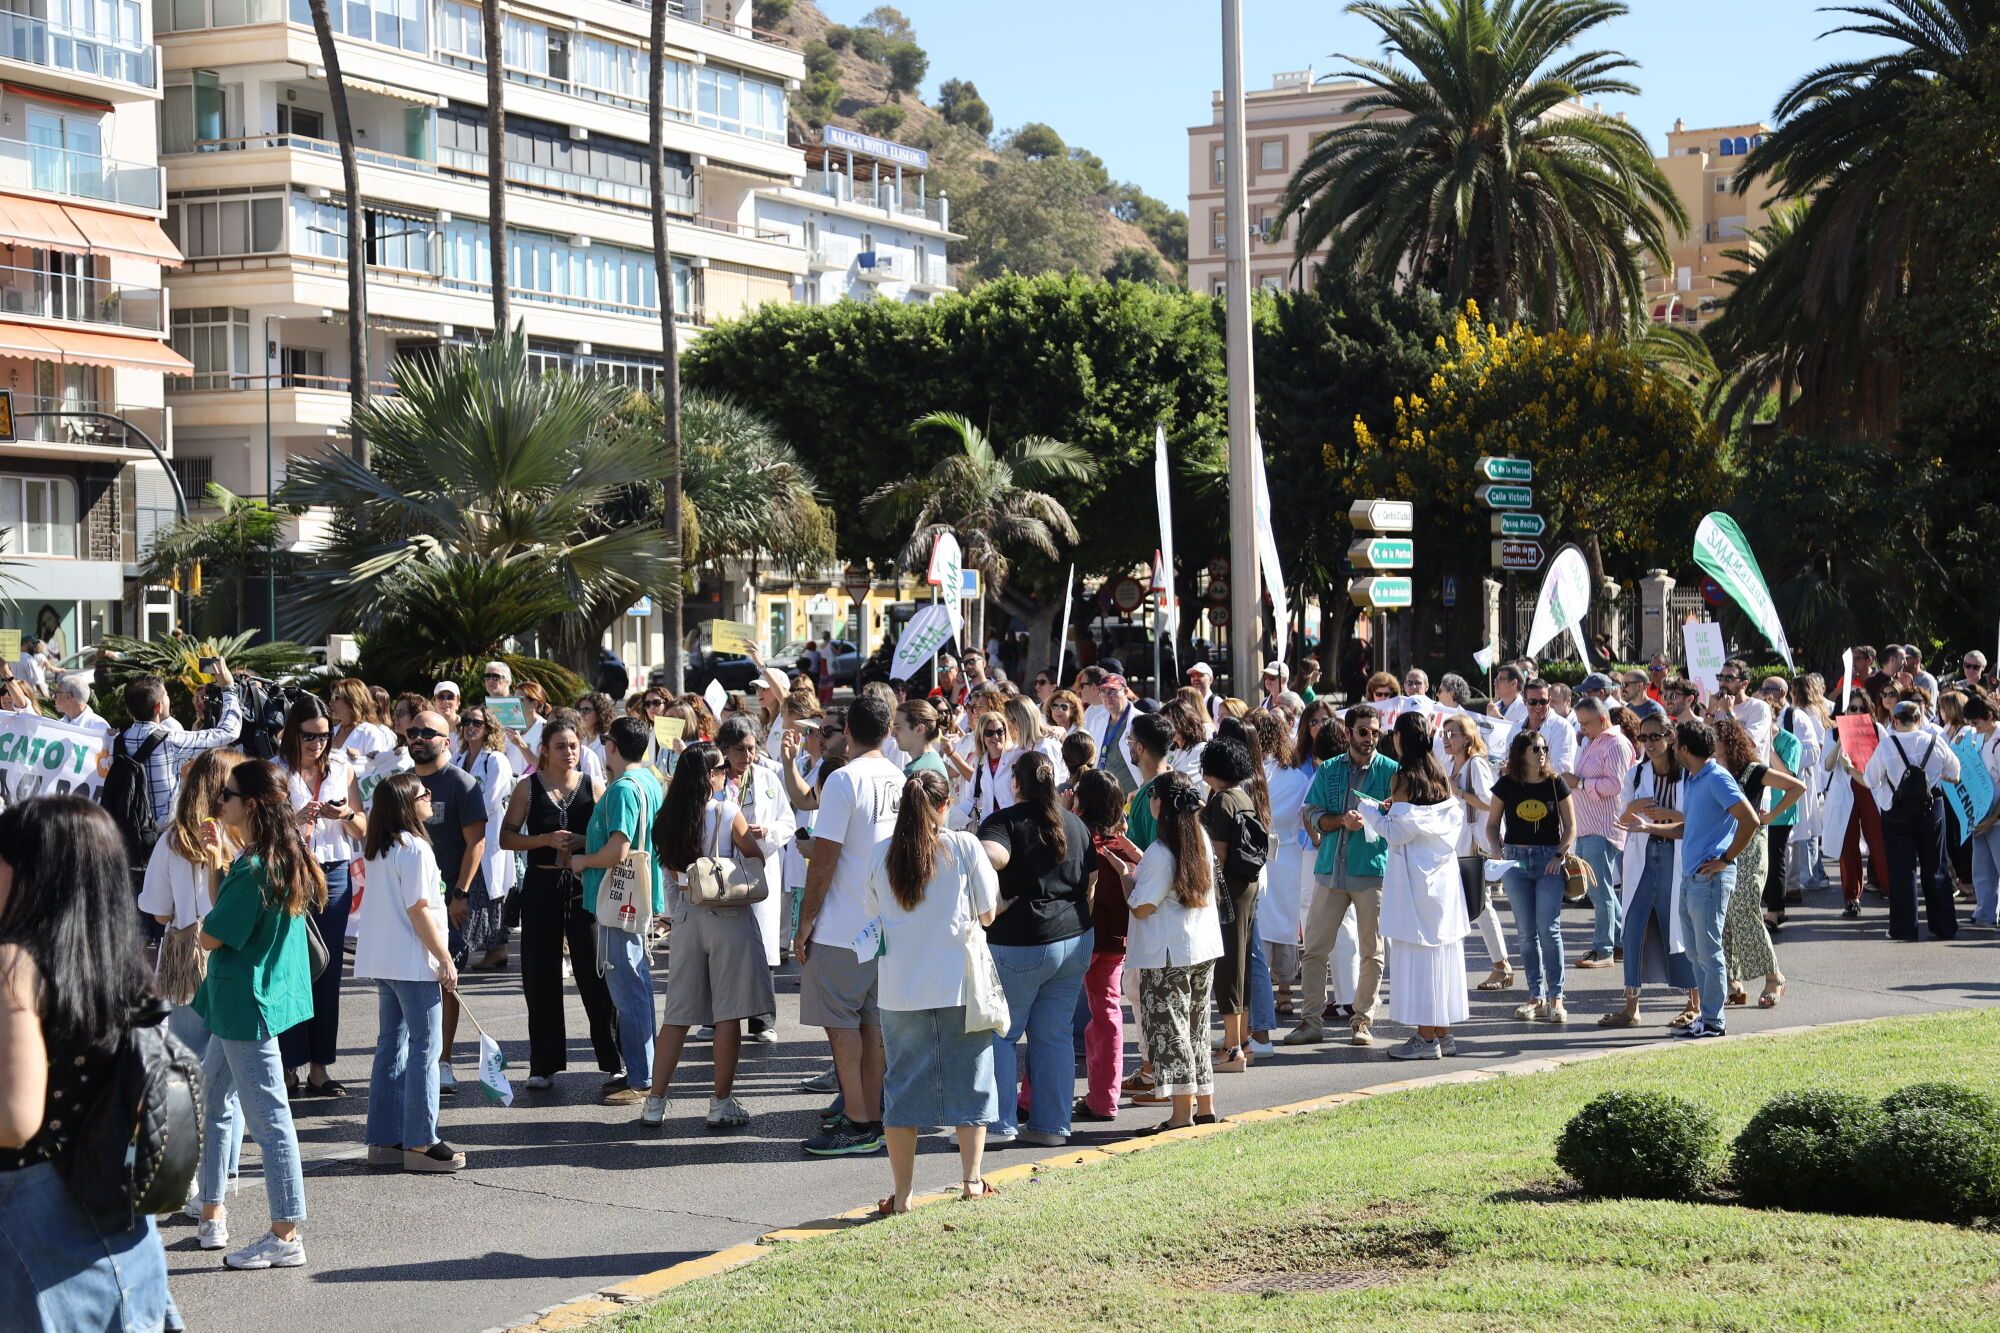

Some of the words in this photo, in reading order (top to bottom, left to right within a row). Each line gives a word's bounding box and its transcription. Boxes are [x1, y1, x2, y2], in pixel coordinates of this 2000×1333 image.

[864, 139, 888, 155] HOTEL
[1498, 464, 1505, 472] de
[1511, 466, 1530, 475] Merced
[1491, 492, 1507, 501] Calle
[1508, 492, 1530, 502] Victoria
[1502, 518, 1518, 528] Paseo
[1520, 519, 1539, 531] Reding
[1381, 548, 1388, 559] de
[1389, 548, 1394, 559] la
[1503, 544, 1521, 554] Castillo
[1522, 545, 1528, 554] de
[1706, 527, 1733, 569] SMA
[1503, 555, 1528, 566] Gibralfaro
[946, 560, 958, 611] SMA
[1382, 586, 1388, 597] de
[1213, 611, 1226, 619] 20
[899, 624, 947, 665] SMA
[72, 743, 89, 774] Y
